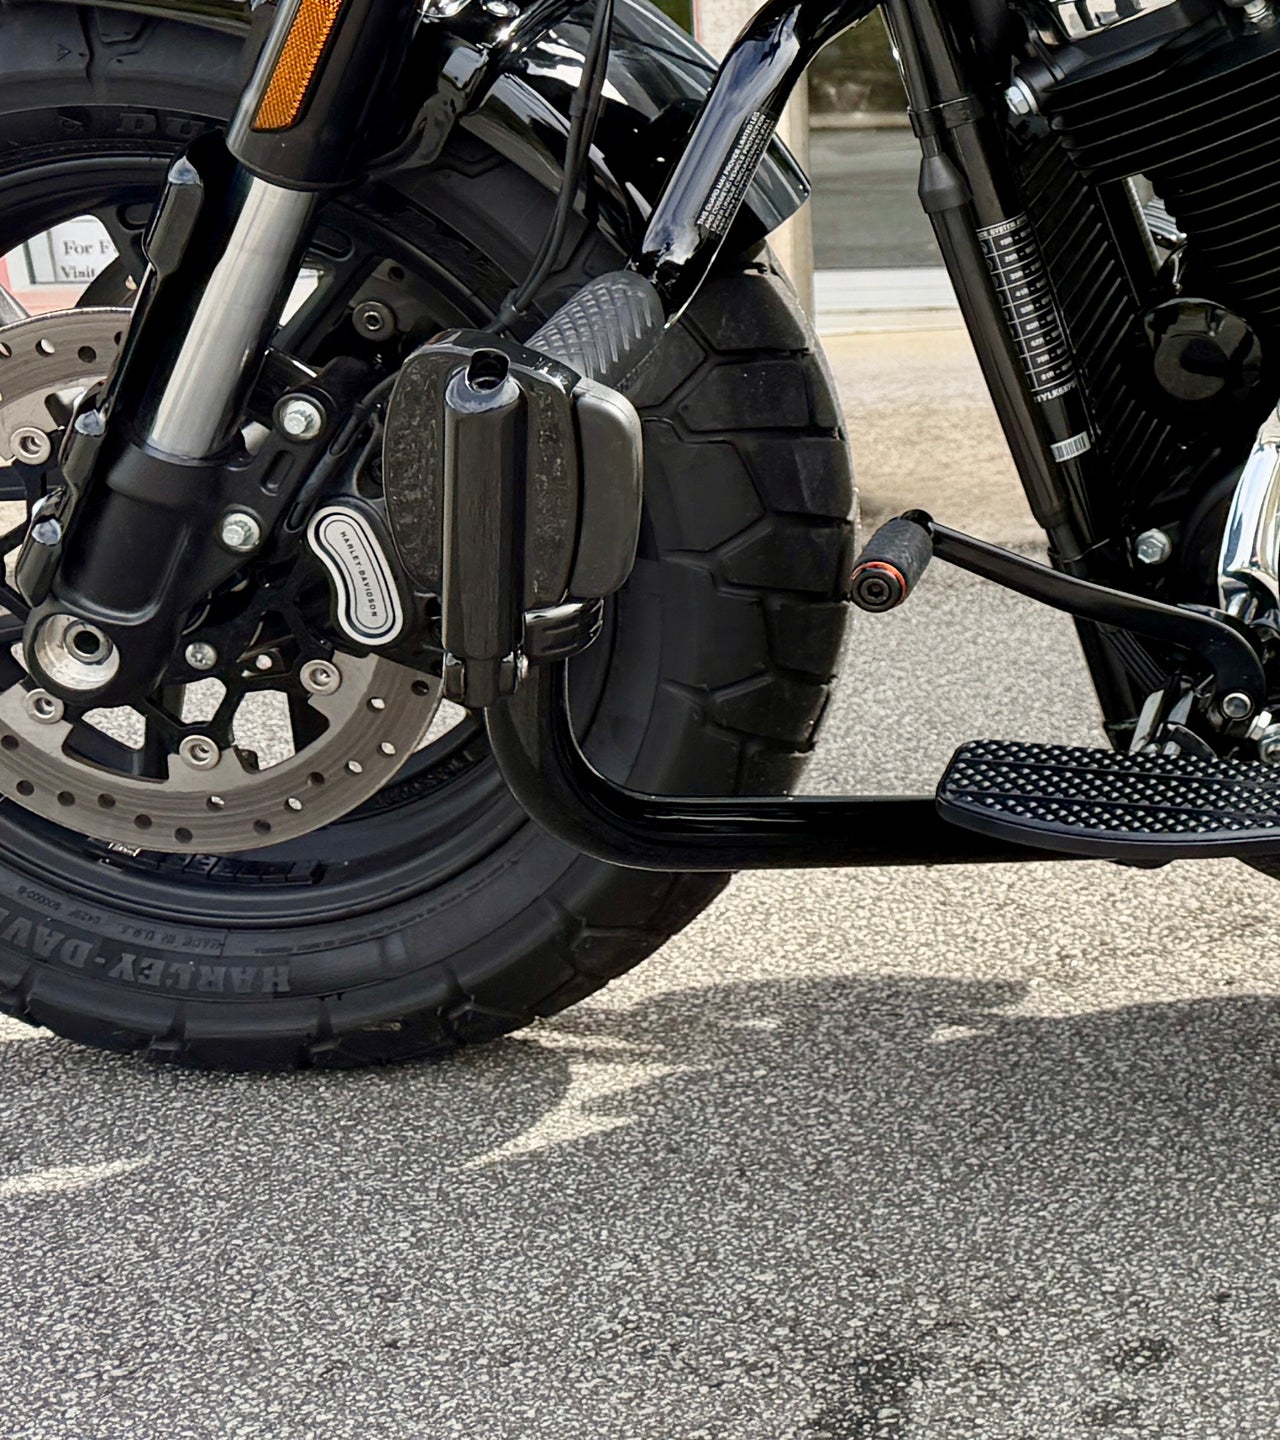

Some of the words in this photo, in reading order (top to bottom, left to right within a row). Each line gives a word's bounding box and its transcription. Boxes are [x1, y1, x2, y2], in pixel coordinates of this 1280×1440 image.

[63, 240, 94, 256] For
[60, 265, 96, 279] Visit
[339, 530, 378, 618] HARLEY-DAVIDSON
